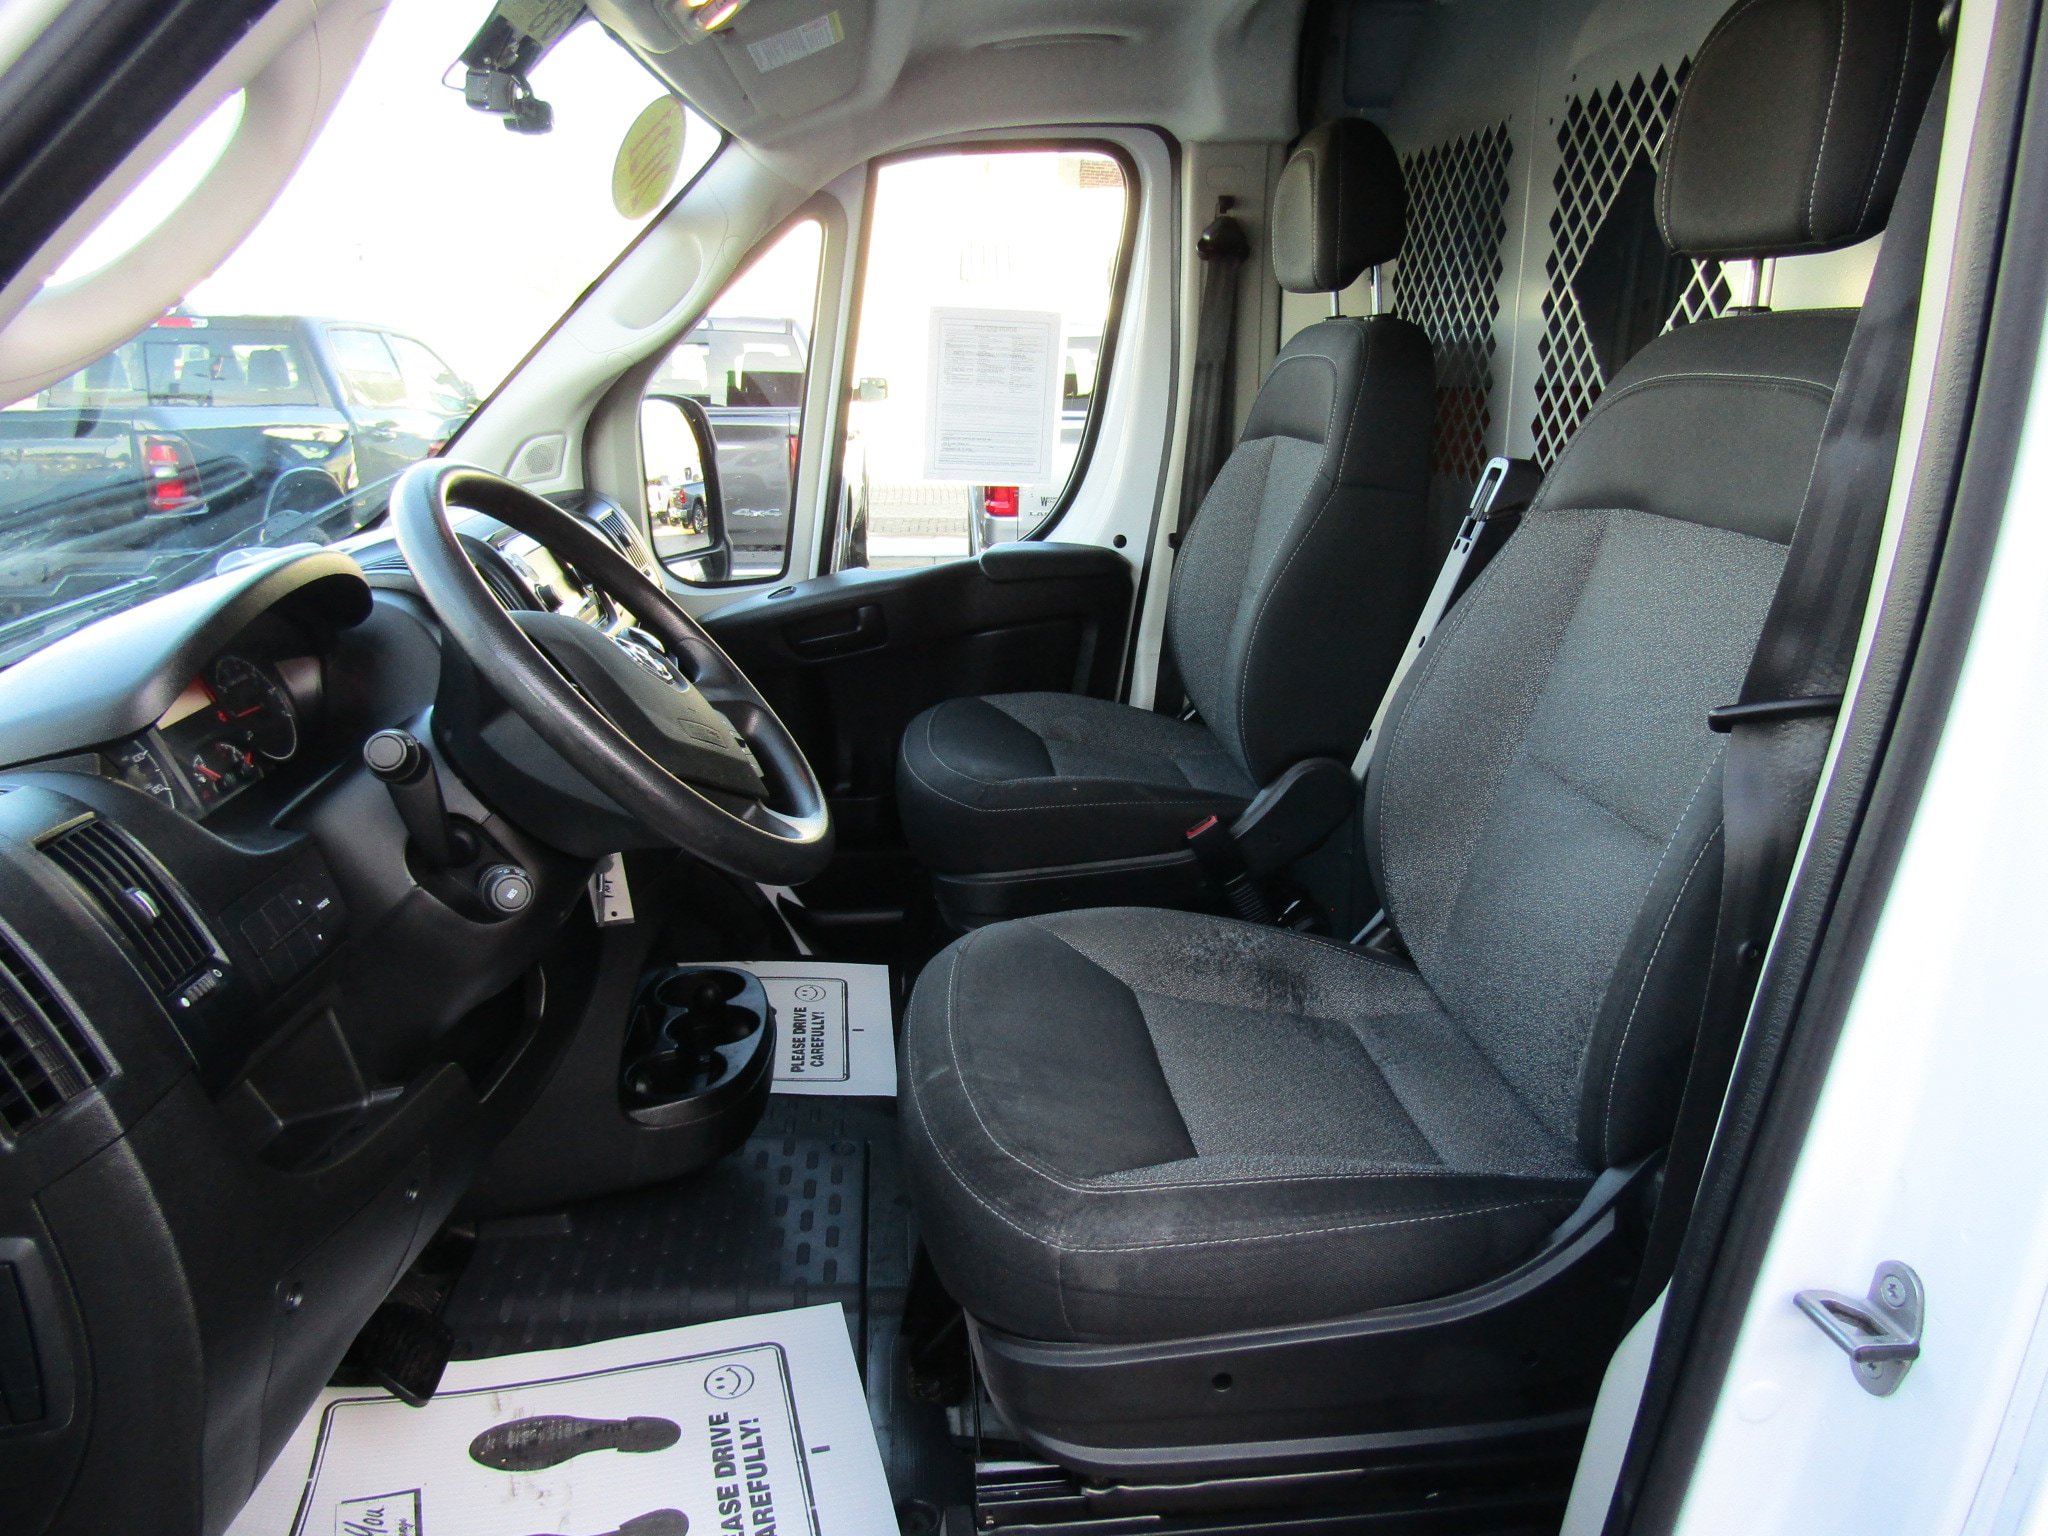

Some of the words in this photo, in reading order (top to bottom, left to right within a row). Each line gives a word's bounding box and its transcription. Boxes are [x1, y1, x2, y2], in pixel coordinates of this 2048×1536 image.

[792, 1006, 807, 1035] DRIVE
[809, 1011, 825, 1068] CAREFULLY!
[790, 1037, 807, 1073] PLEASE
[708, 1411, 737, 1479] DRIVE
